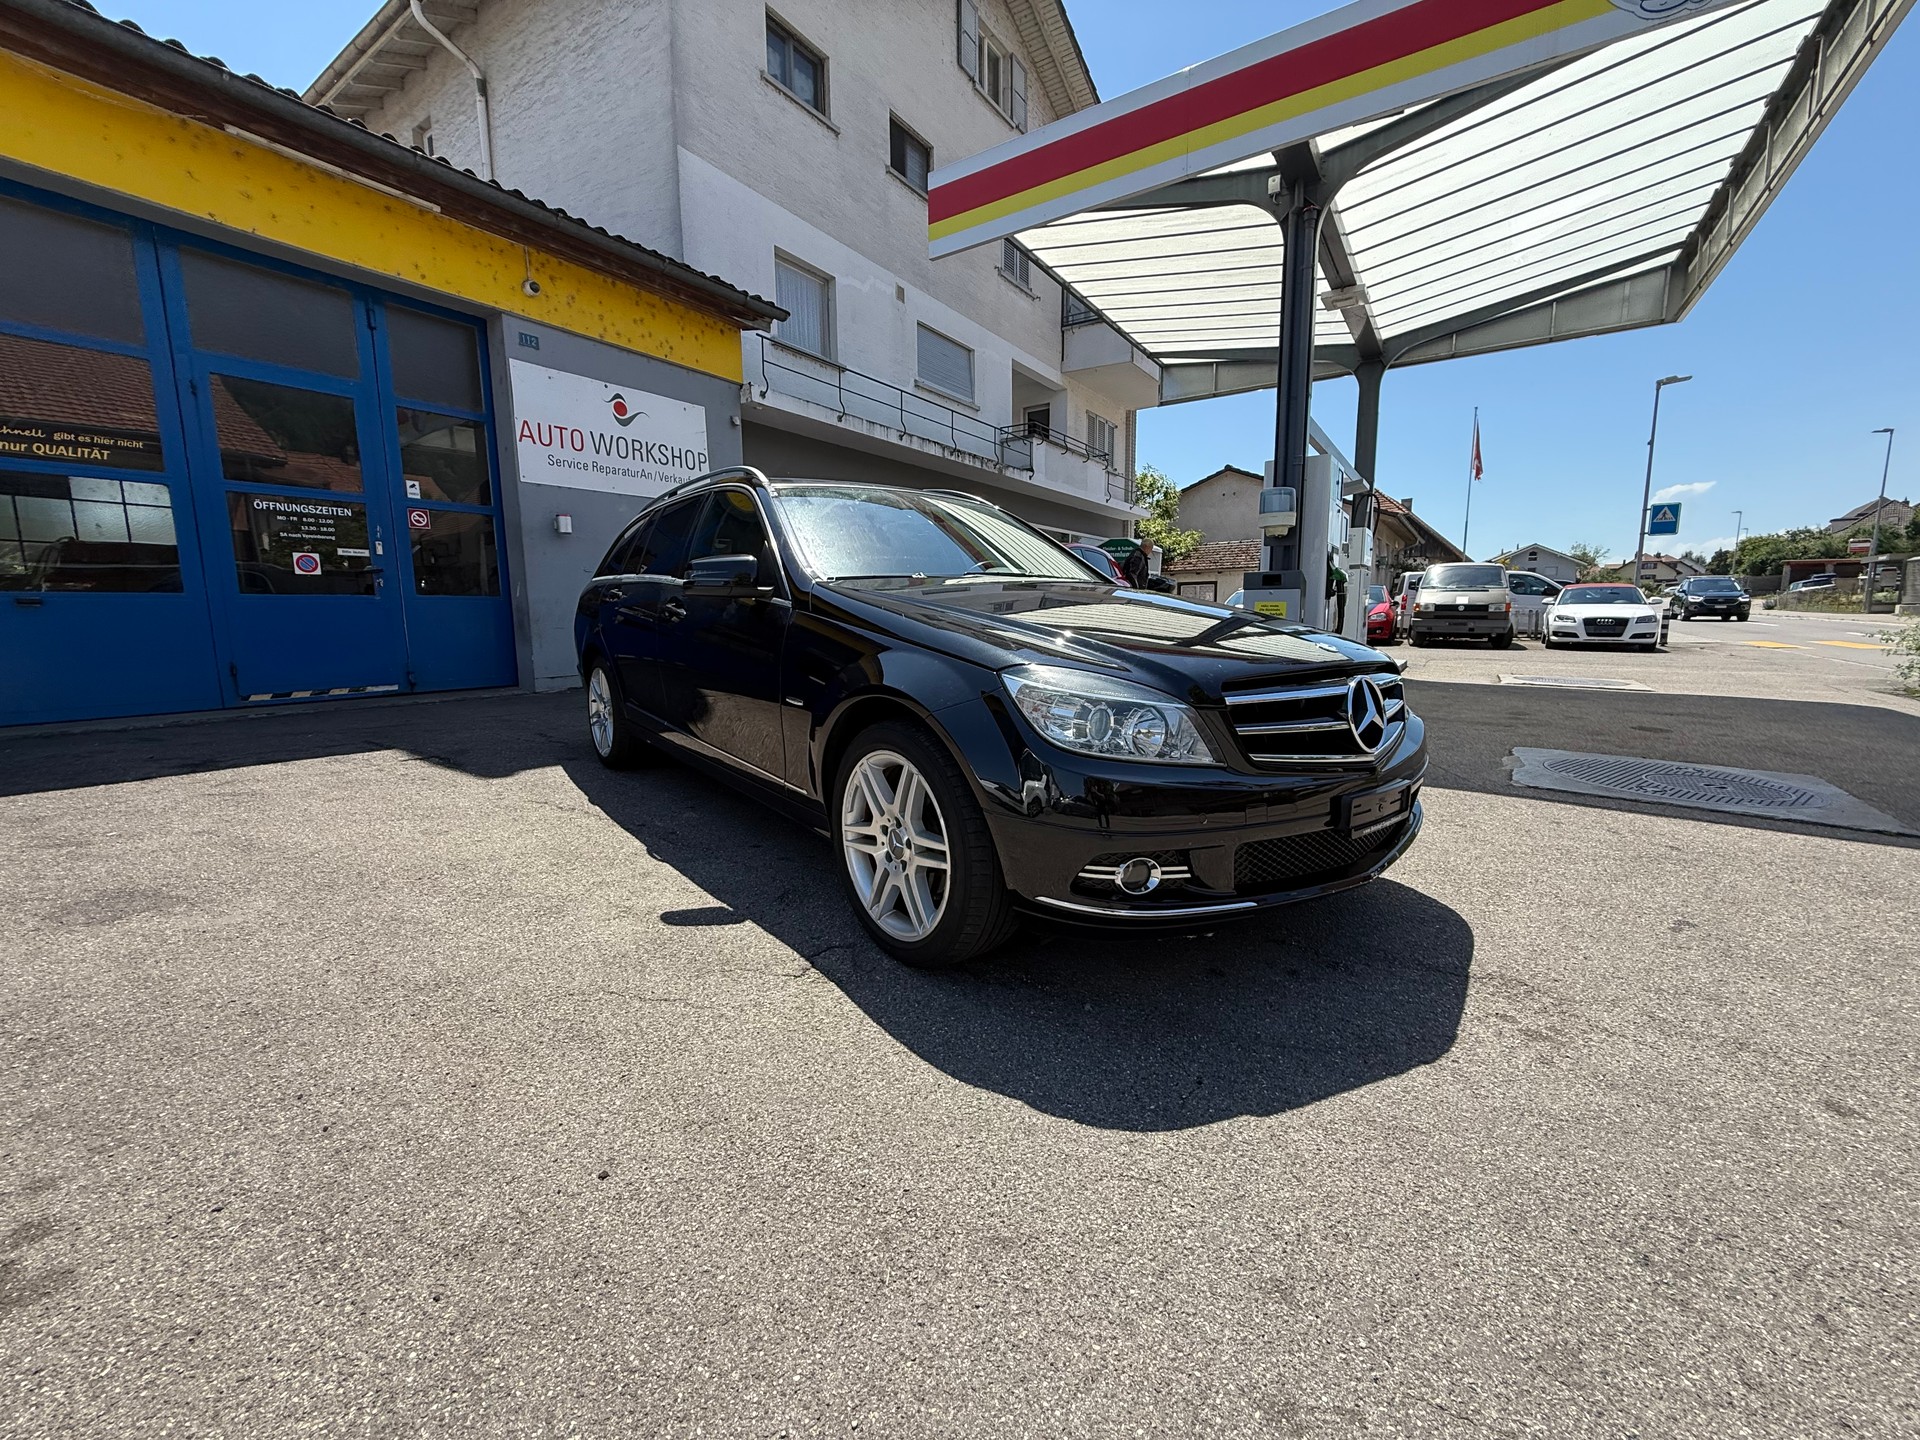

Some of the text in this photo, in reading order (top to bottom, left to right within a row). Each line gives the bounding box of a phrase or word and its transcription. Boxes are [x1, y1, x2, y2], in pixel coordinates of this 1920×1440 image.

[520, 334, 537, 347] 112
[0, 425, 144, 449] hnell gibt es hier nicht
[518, 419, 708, 472] AUTO WORKSHOP
[0, 441, 111, 460] nur QUALITÄT
[547, 454, 589, 471] Service
[253, 499, 352, 517] ÖFFNUNGSZEITEN
